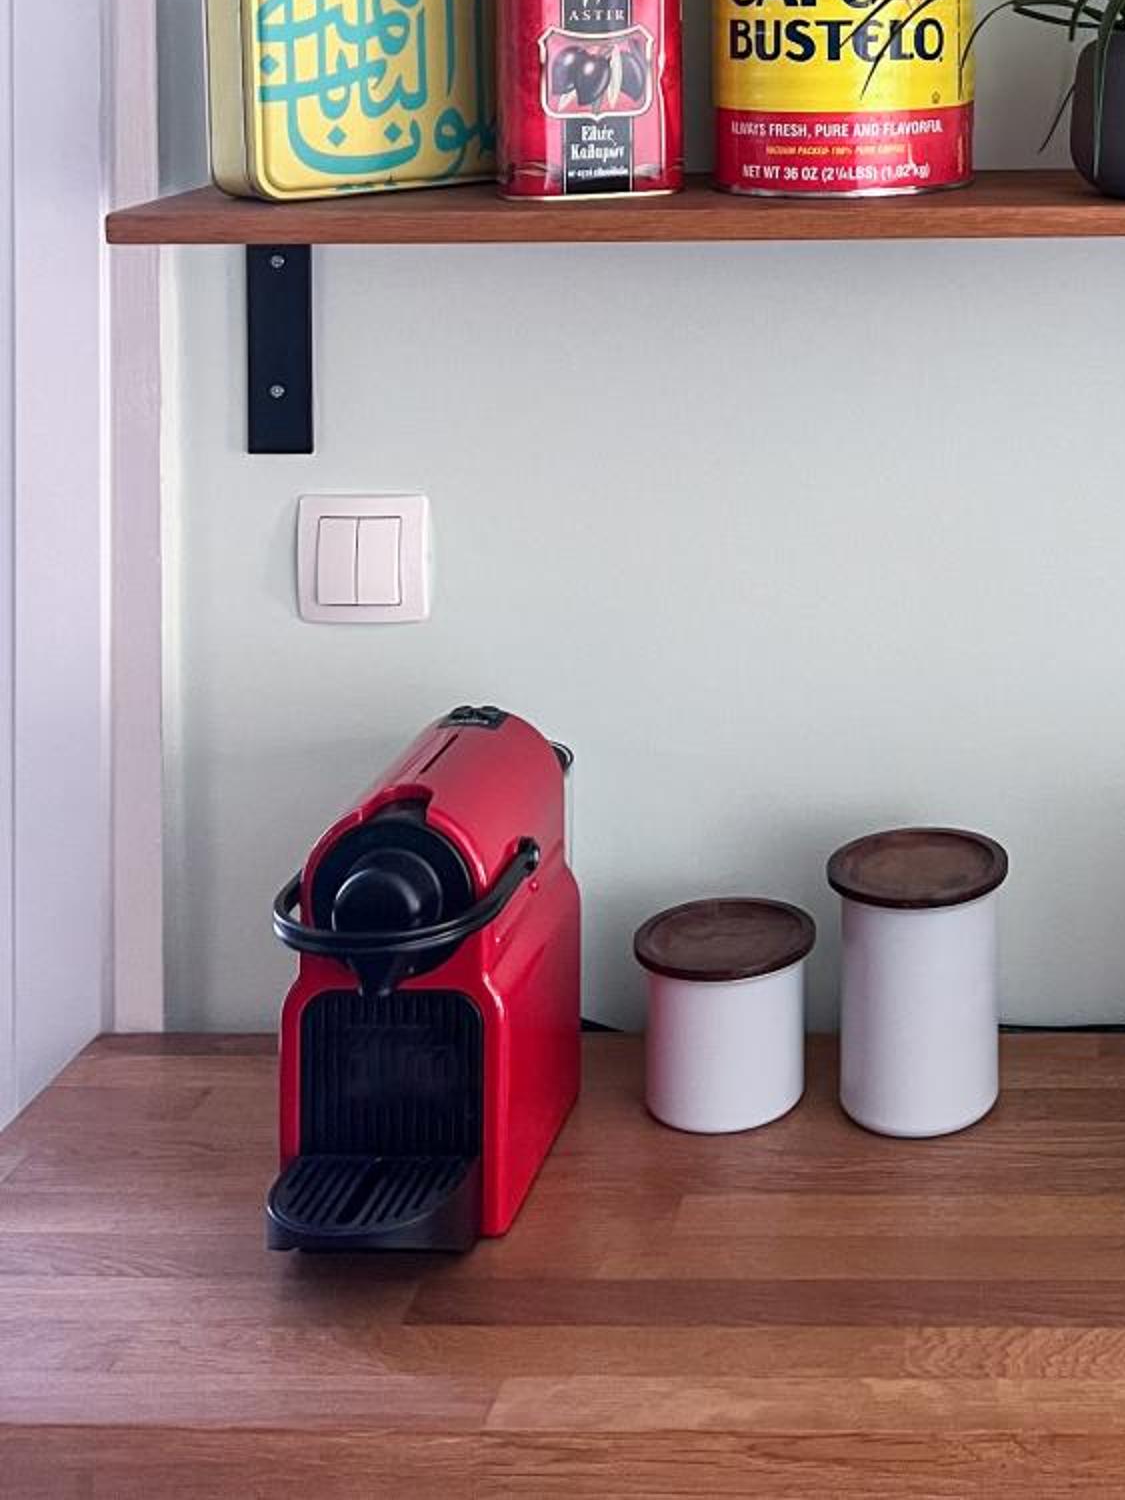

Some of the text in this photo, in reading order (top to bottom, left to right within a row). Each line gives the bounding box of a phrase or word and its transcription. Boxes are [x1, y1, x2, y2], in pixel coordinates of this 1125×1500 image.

[569, 9, 625, 21] ASTIR
[729, 18, 945, 62] BUSTELO
[768, 122, 813, 140] FRESH,
[815, 122, 849, 138] PURE
[853, 121, 878, 137] AND
[882, 119, 944, 138] FLAVORFUL
[742, 164, 761, 178] NET
[763, 164, 781, 179] WT
[784, 165, 799, 180] 36
[802, 165, 818, 181] OZ
